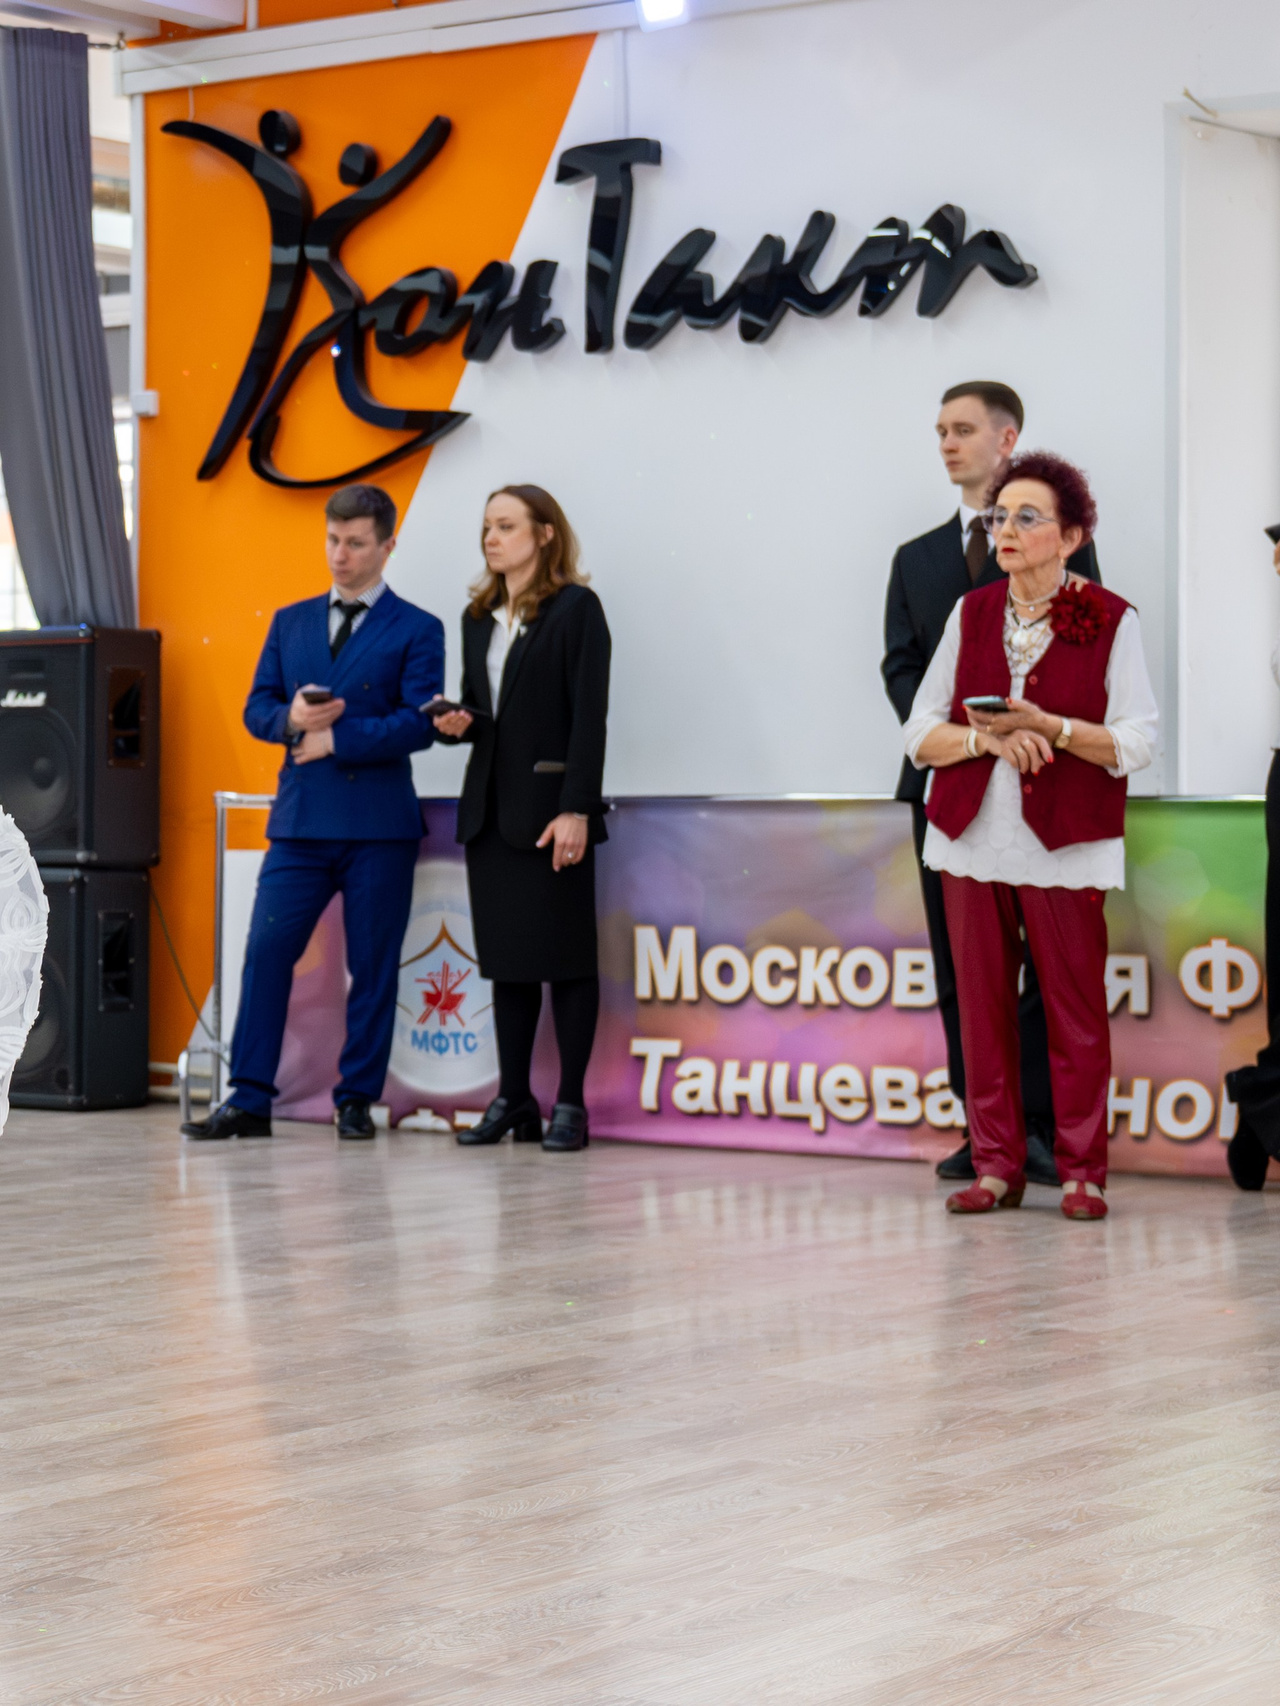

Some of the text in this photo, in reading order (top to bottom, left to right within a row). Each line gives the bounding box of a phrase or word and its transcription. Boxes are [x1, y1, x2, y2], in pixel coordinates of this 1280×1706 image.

[632, 924, 1263, 1019] Московя Ф
[411, 1029, 478, 1056] МФТС
[628, 1037, 1239, 1141] Танцевано
